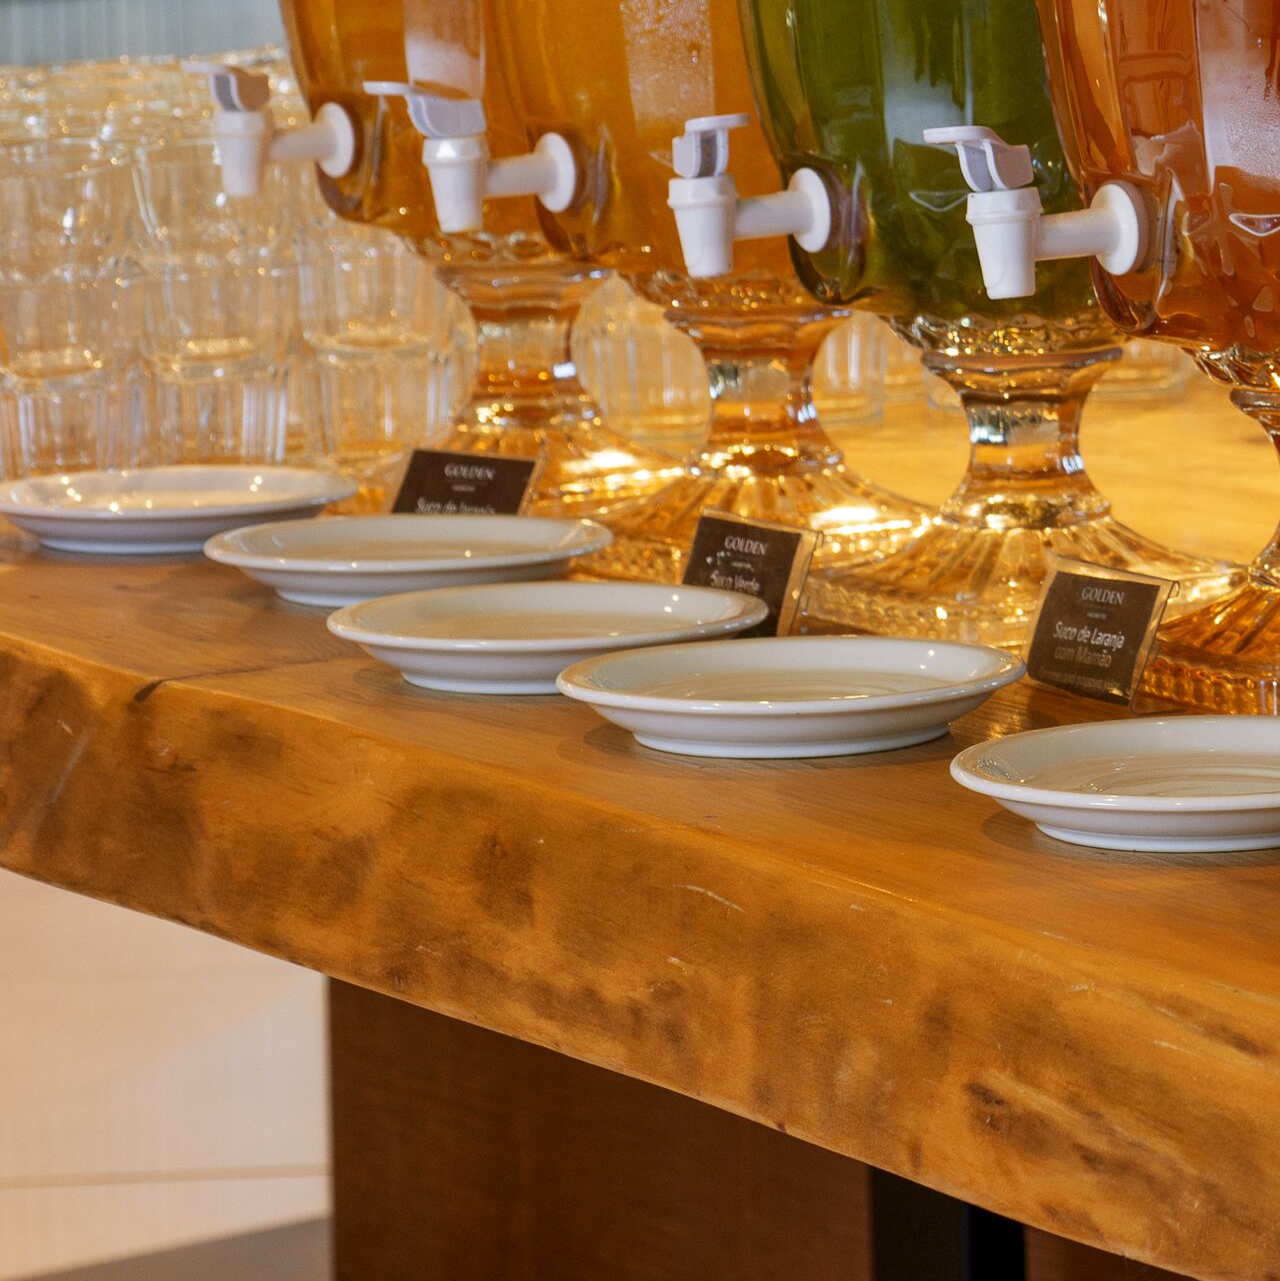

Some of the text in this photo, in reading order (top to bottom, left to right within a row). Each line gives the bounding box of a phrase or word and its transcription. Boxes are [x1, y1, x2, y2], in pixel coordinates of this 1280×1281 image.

[724, 535, 768, 555] GOLDEN
[1081, 587, 1125, 605] GOLDEN
[1052, 621, 1126, 652] Suco de Laranja
